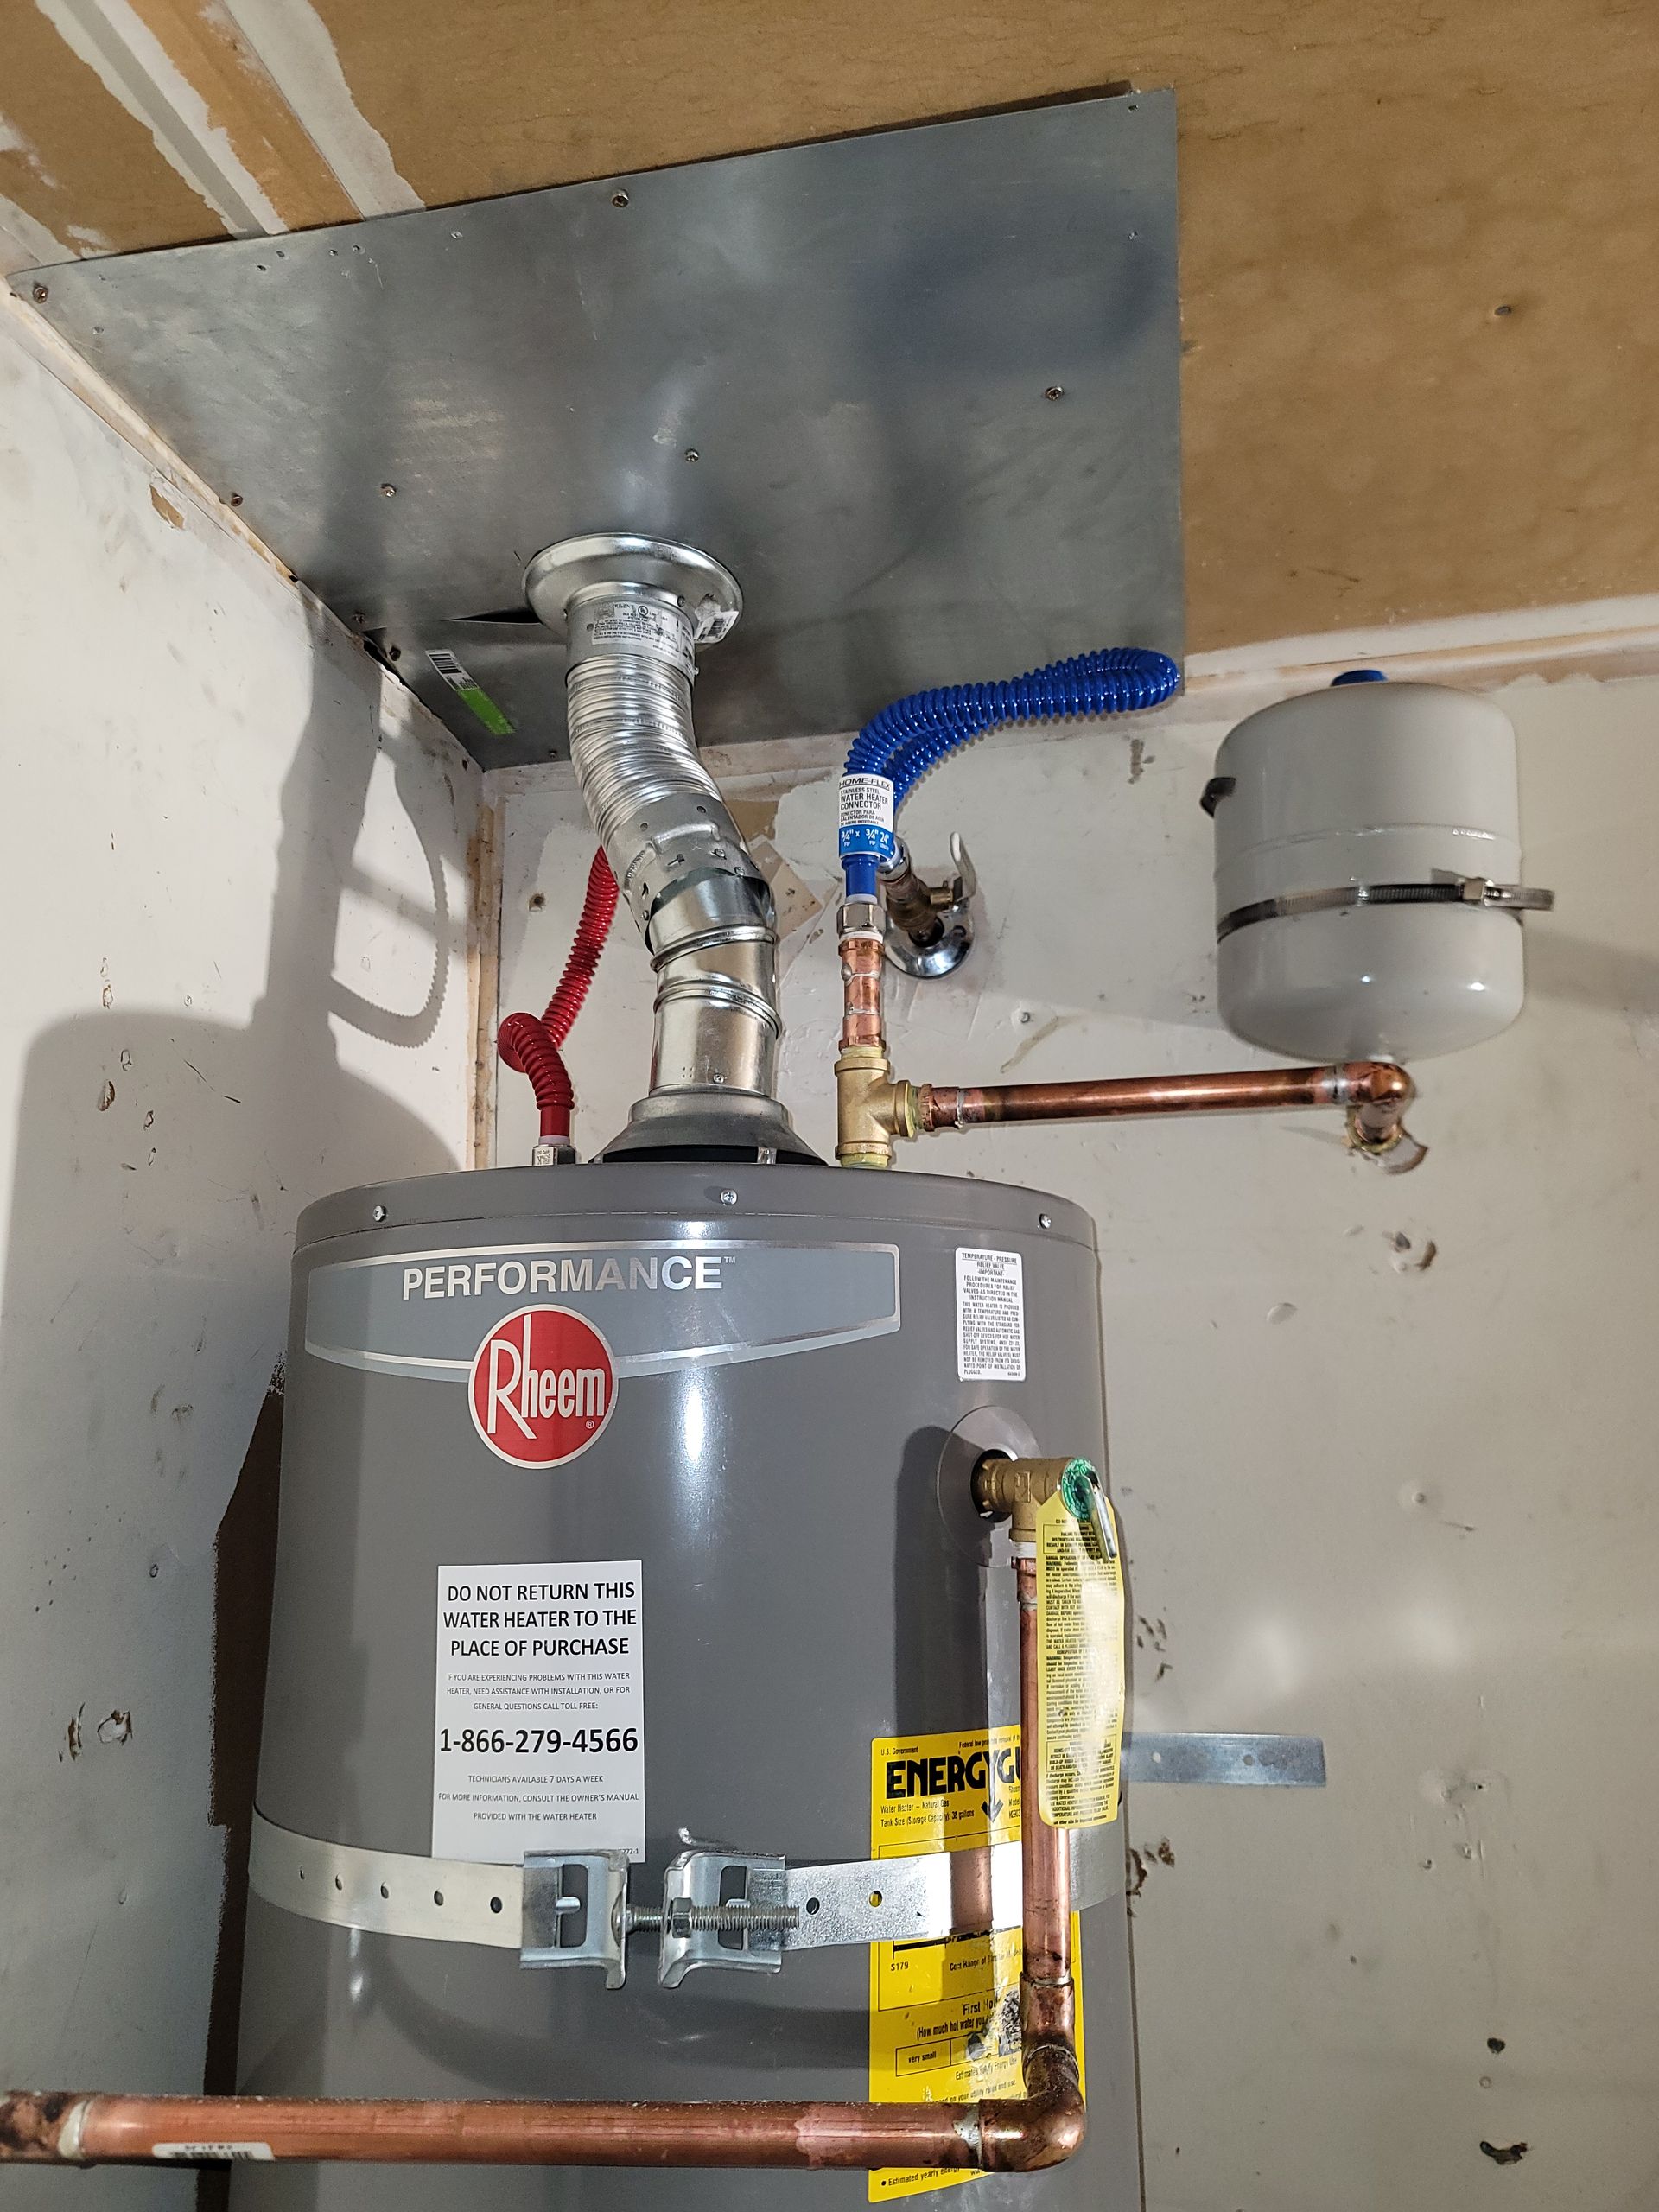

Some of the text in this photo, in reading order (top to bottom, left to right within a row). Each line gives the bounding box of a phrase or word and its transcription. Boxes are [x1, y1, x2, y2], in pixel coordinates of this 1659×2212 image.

[839, 778, 890, 789] HOME-FLEX
[841, 793, 888, 805] WATER HEATER
[841, 801, 881, 810] CONNECTOR
[403, 1256, 722, 1300] PERFORMANCE
[487, 1314, 605, 1439] Rheem
[448, 1582, 634, 1601] DO NOT RETURN THIS
[443, 1610, 636, 1629] WATER HEATER TO THE
[452, 1638, 629, 1656] PLACE OF PURCHASE
[441, 1728, 638, 1753] 1-866-279-4566
[893, 1746, 918, 1755] Government
[881, 1805, 896, 1814] Water
[898, 1803, 913, 1812] Heater
[923, 1800, 938, 1809] Natural
[890, 1961, 909, 1972] $179
[963, 2001, 980, 2015] First
[917, 2025, 931, 2040] (How
[933, 2022, 948, 2036] much
[960, 2018, 974, 2029] water
[922, 2051, 936, 2061] small
[888, 2172, 918, 2186] Estimated
[921, 2170, 939, 2181] yearly
